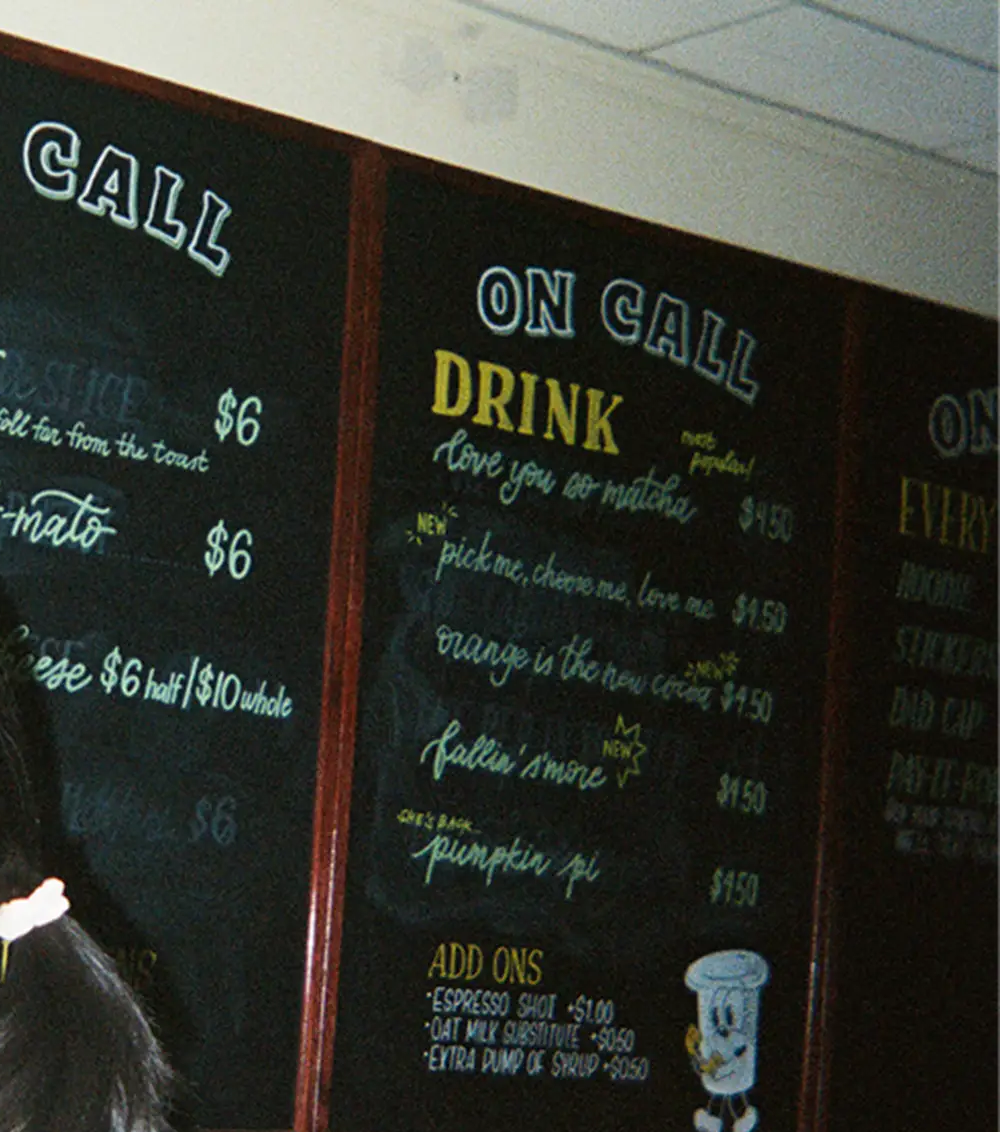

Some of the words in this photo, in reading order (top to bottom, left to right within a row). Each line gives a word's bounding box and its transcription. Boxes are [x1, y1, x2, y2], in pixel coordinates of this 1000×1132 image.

[22, 121, 232, 277] CALL
[476, 266, 576, 338] ON
[601, 278, 761, 405] CALL
[214, 387, 264, 446] $6
[431, 349, 624, 455] DRINK
[32, 415, 63, 446] far
[65, 420, 112, 457] from
[114, 431, 149, 460] the
[151, 439, 210, 473] toast
[433, 429, 504, 479] love
[498, 457, 558, 506] you
[600, 464, 699, 524] matcha
[203, 519, 254, 580] $6
[416, 511, 448, 537] NEW
[434, 528, 494, 583] pick
[532, 552, 596, 596] choose
[637, 571, 682, 610] love
[684, 594, 716, 621] me
[99, 646, 142, 697] $6
[241, 680, 293, 718] whole
[436, 625, 531, 689] orange
[532, 649, 555, 676] is
[559, 635, 601, 681] the
[601, 664, 651, 697] new
[602, 739, 632, 759] NEW
[412, 834, 552, 887] pumpkin
[557, 850, 602, 899] pi
[427, 942, 485, 981] ADD
[492, 946, 545, 985] ONS
[429, 1016, 462, 1041] OAT
[464, 1019, 500, 1045] MILK
[502, 1020, 581, 1049] SUBSTITUTE
[432, 986, 511, 1017] ESPRESSO
[516, 992, 558, 1020] SHOT
[427, 1044, 476, 1073] EXTRA
[480, 1047, 524, 1075] PUMP
[526, 1050, 547, 1077] OF
[550, 1051, 601, 1080] SYRUP
